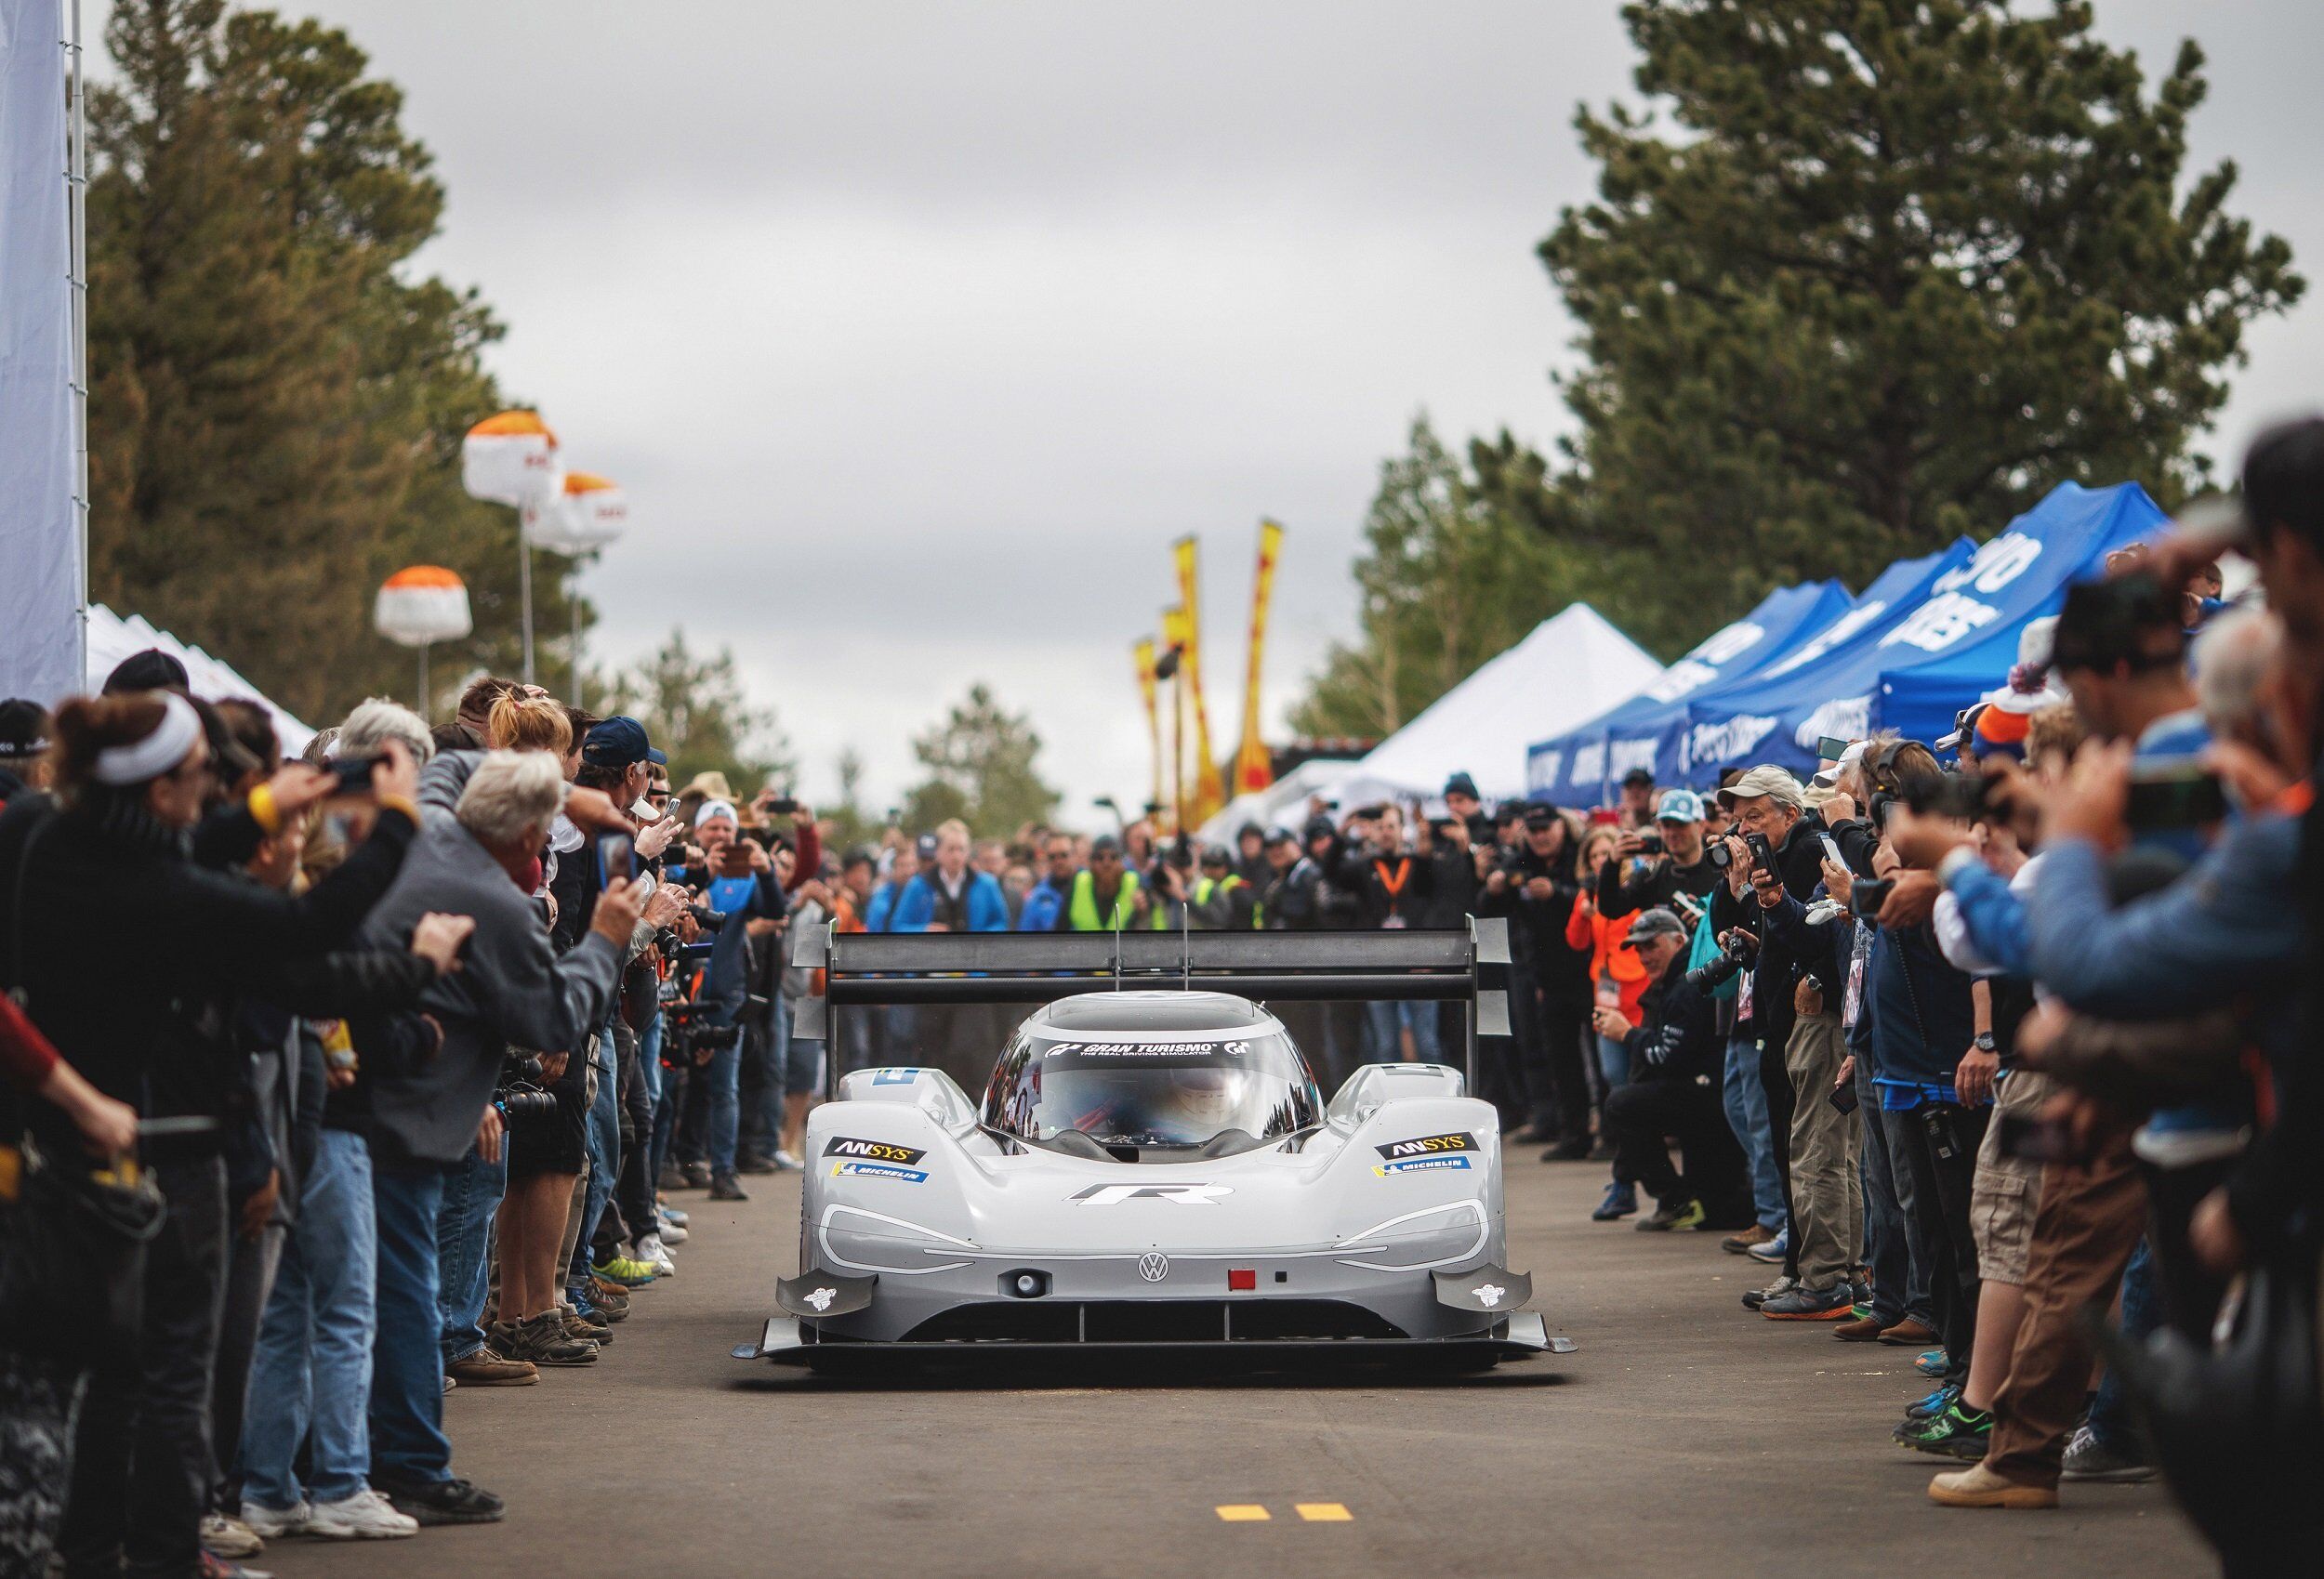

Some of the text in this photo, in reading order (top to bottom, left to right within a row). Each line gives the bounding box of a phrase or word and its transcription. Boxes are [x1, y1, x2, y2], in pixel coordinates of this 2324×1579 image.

[1083, 1043, 1212, 1053] GRAN TURISMO
[834, 1140, 913, 1160] ANSYS
[1393, 1136, 1465, 1155] ANSYS
[1402, 1160, 1462, 1171] MICHELIN
[858, 1166, 919, 1179] MICHELIN
